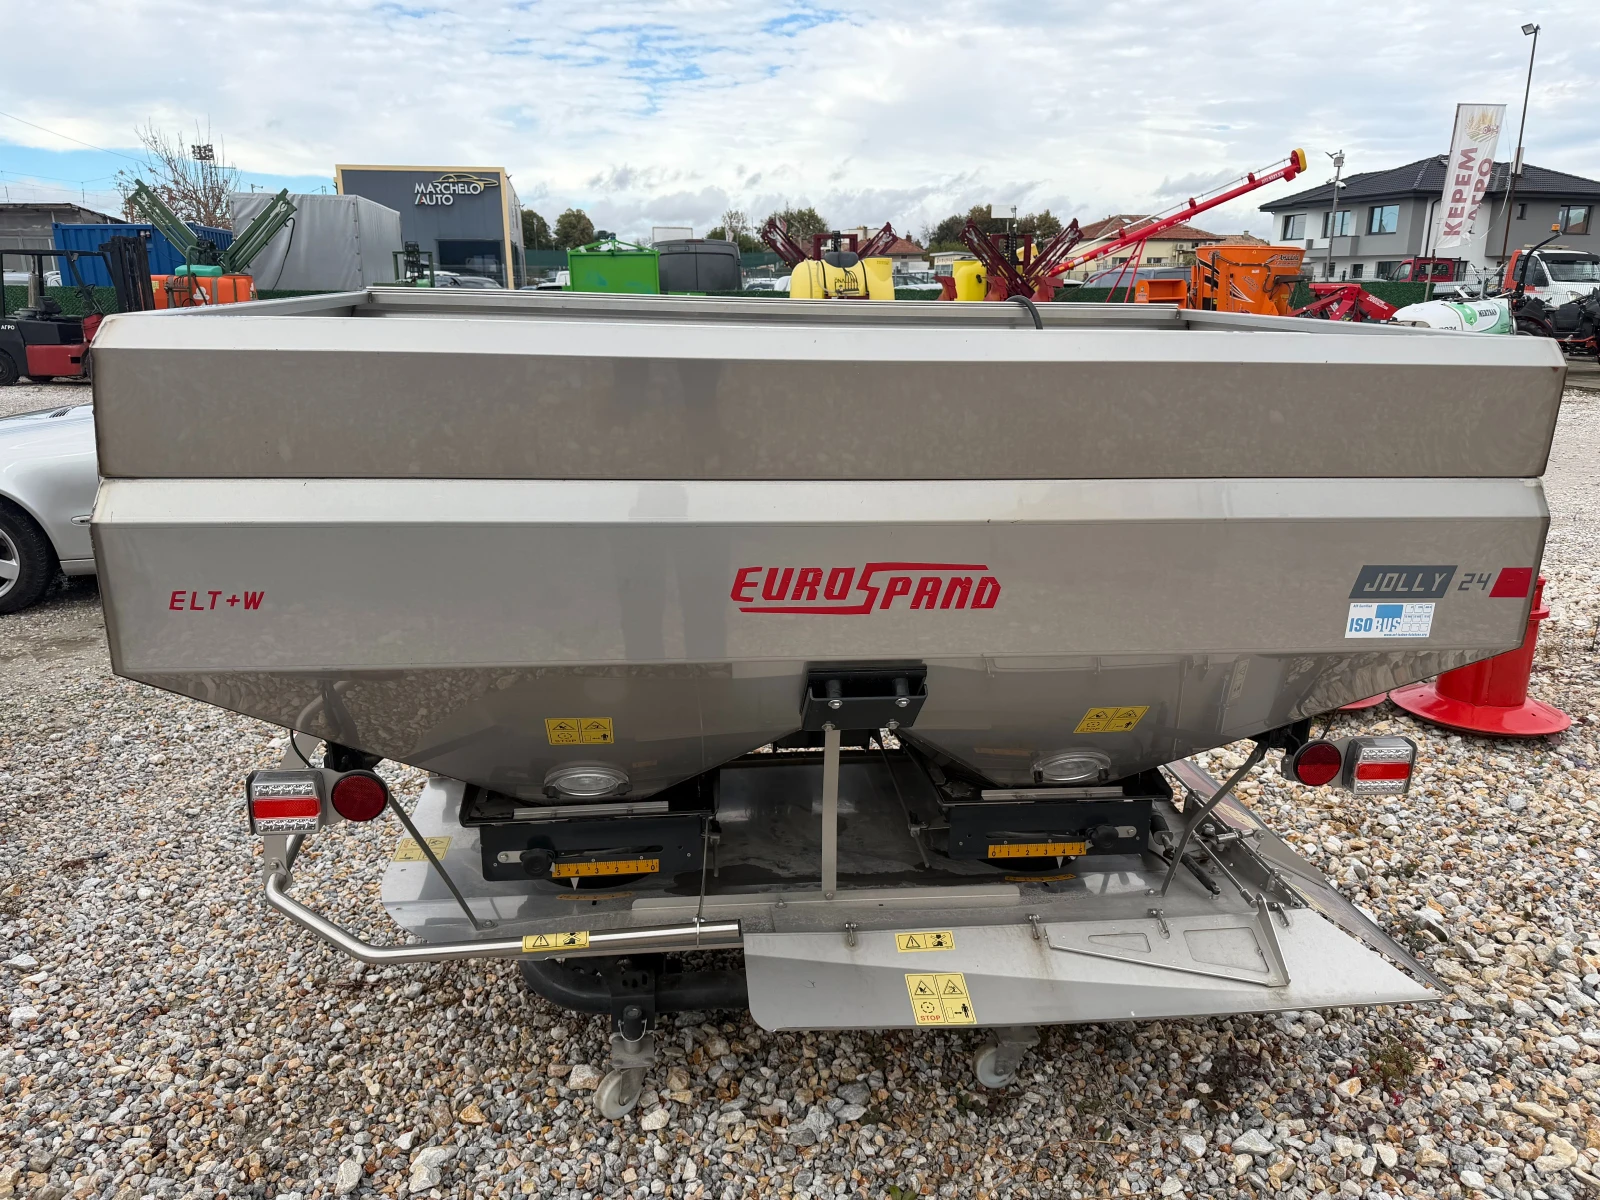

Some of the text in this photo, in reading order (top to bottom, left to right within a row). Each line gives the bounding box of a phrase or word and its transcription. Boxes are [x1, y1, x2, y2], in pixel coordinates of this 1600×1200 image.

[414, 182, 481, 195] MARCHELO
[1443, 147, 1478, 236] КЕРЕМ
[415, 194, 454, 206] AUTO
[730, 562, 1002, 615] EUROSPAND
[1363, 573, 1492, 592] JOLLY 24
[168, 590, 265, 611] ELT+W
